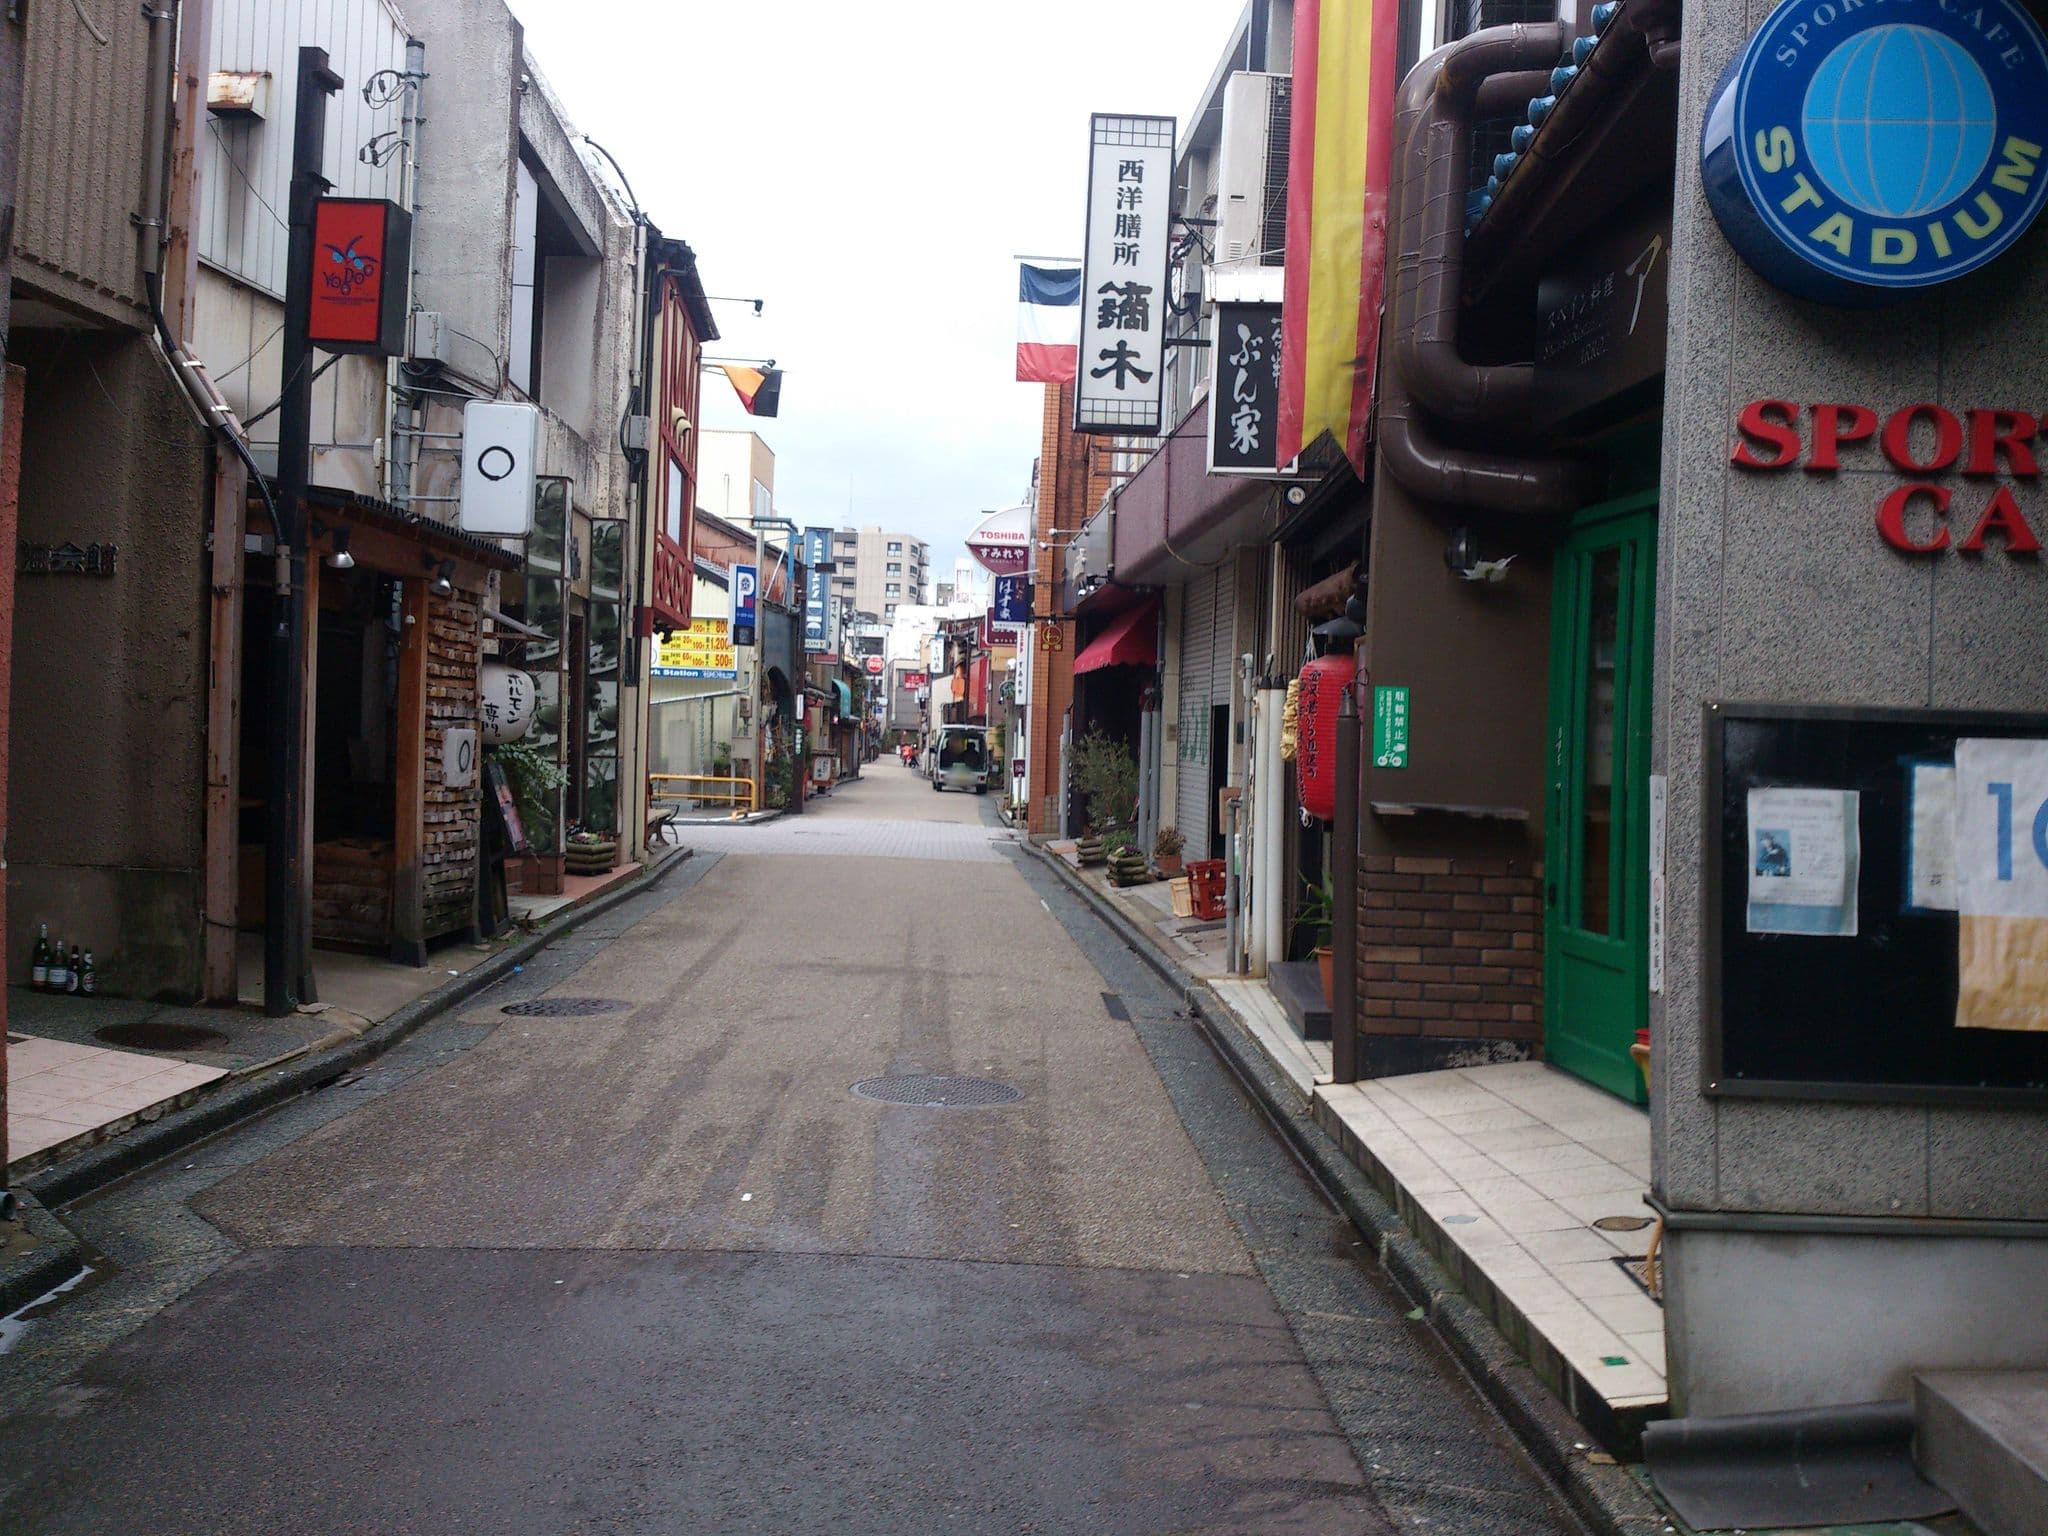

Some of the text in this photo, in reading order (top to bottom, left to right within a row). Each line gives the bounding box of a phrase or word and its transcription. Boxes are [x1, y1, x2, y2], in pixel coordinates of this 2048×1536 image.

[1112, 158, 1146, 268] 西洋膳所
[1755, 125, 2043, 266] STADIUM
[1229, 322, 1264, 455] ぶん家
[1729, 398, 2048, 477] SPOR
[980, 530, 1026, 540] TOSHIBA
[980, 547, 1026, 560] すみれや
[736, 572, 755, 608] P
[663, 668, 699, 678] Station
[507, 674, 524, 724] ホルモン
